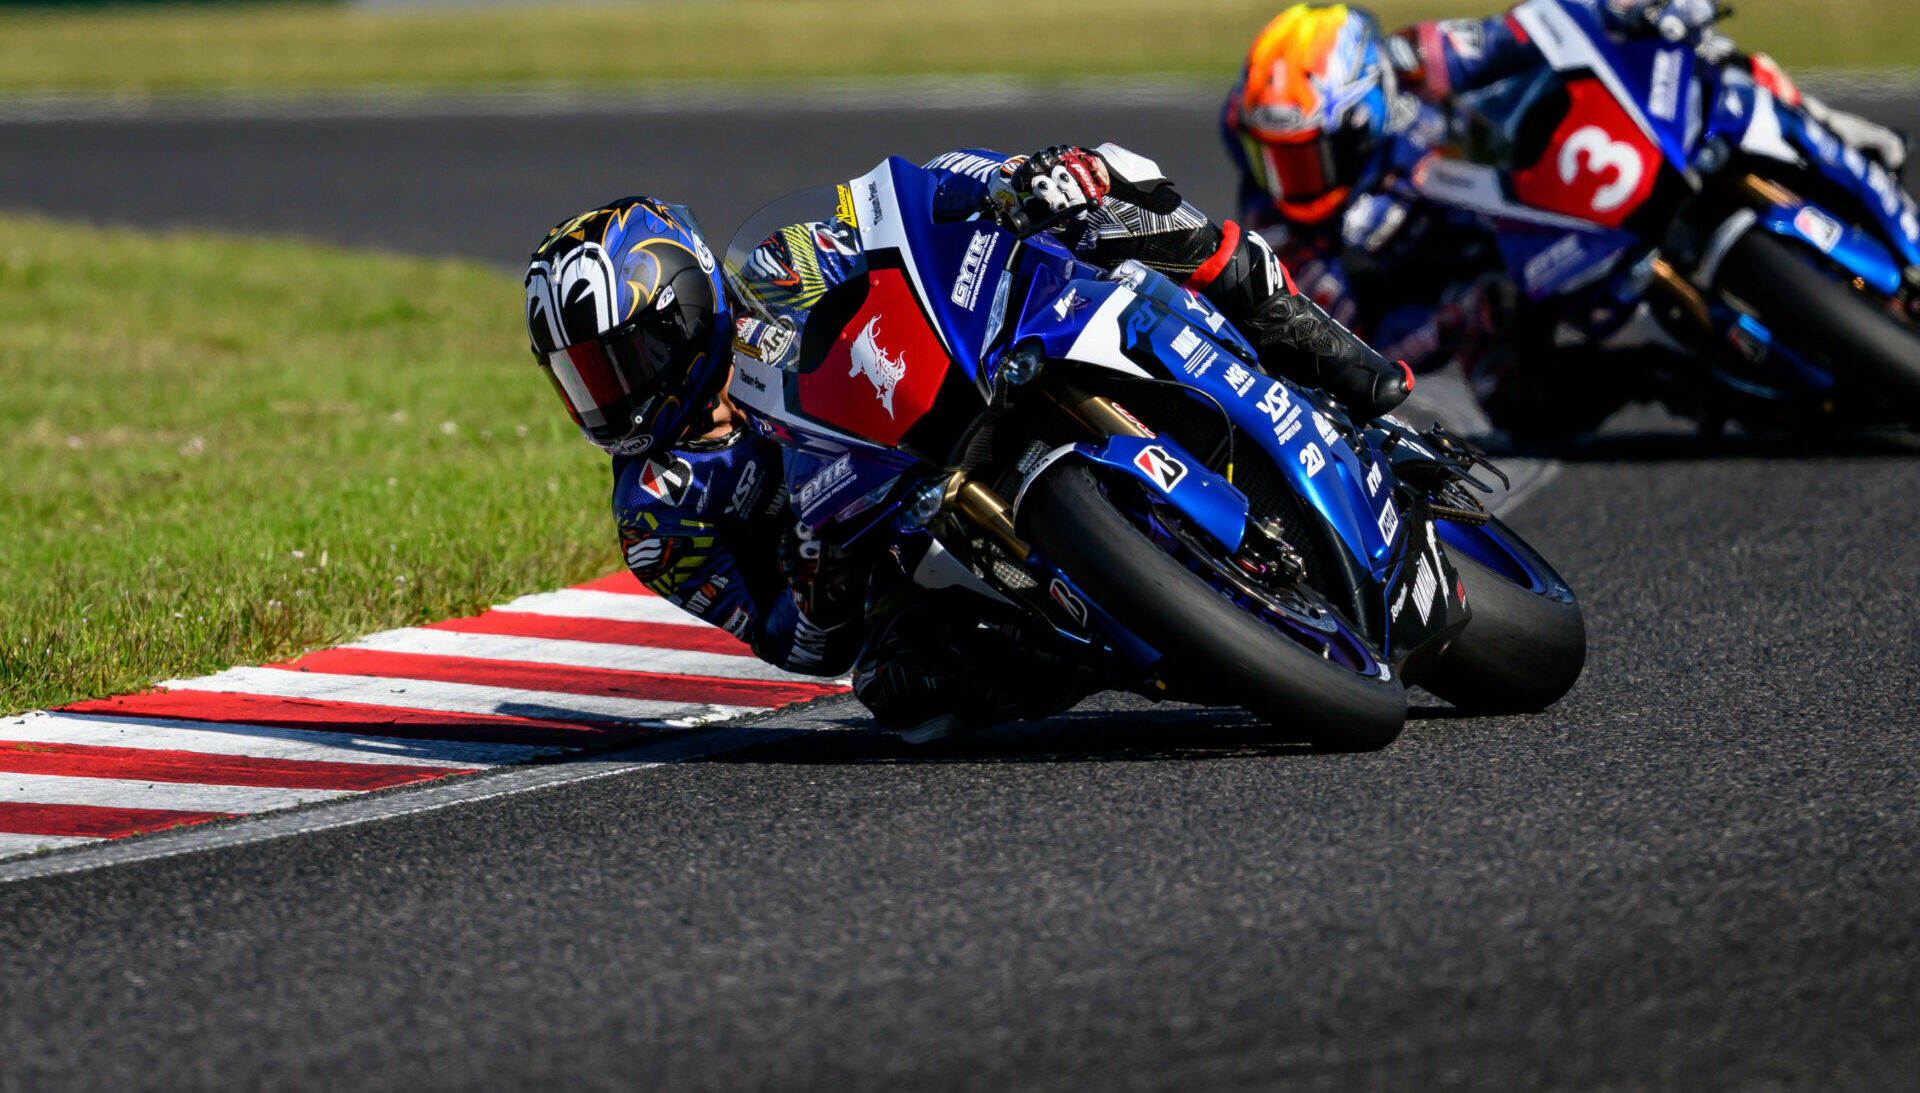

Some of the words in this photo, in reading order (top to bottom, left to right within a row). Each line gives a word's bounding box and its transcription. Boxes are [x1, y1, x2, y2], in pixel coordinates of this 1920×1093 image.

[1558, 125, 1642, 211] 3
[951, 229, 990, 307] GYTR
[1223, 362, 1250, 391] NGK
[1256, 380, 1291, 423] YSP
[800, 453, 853, 507] GYTR
